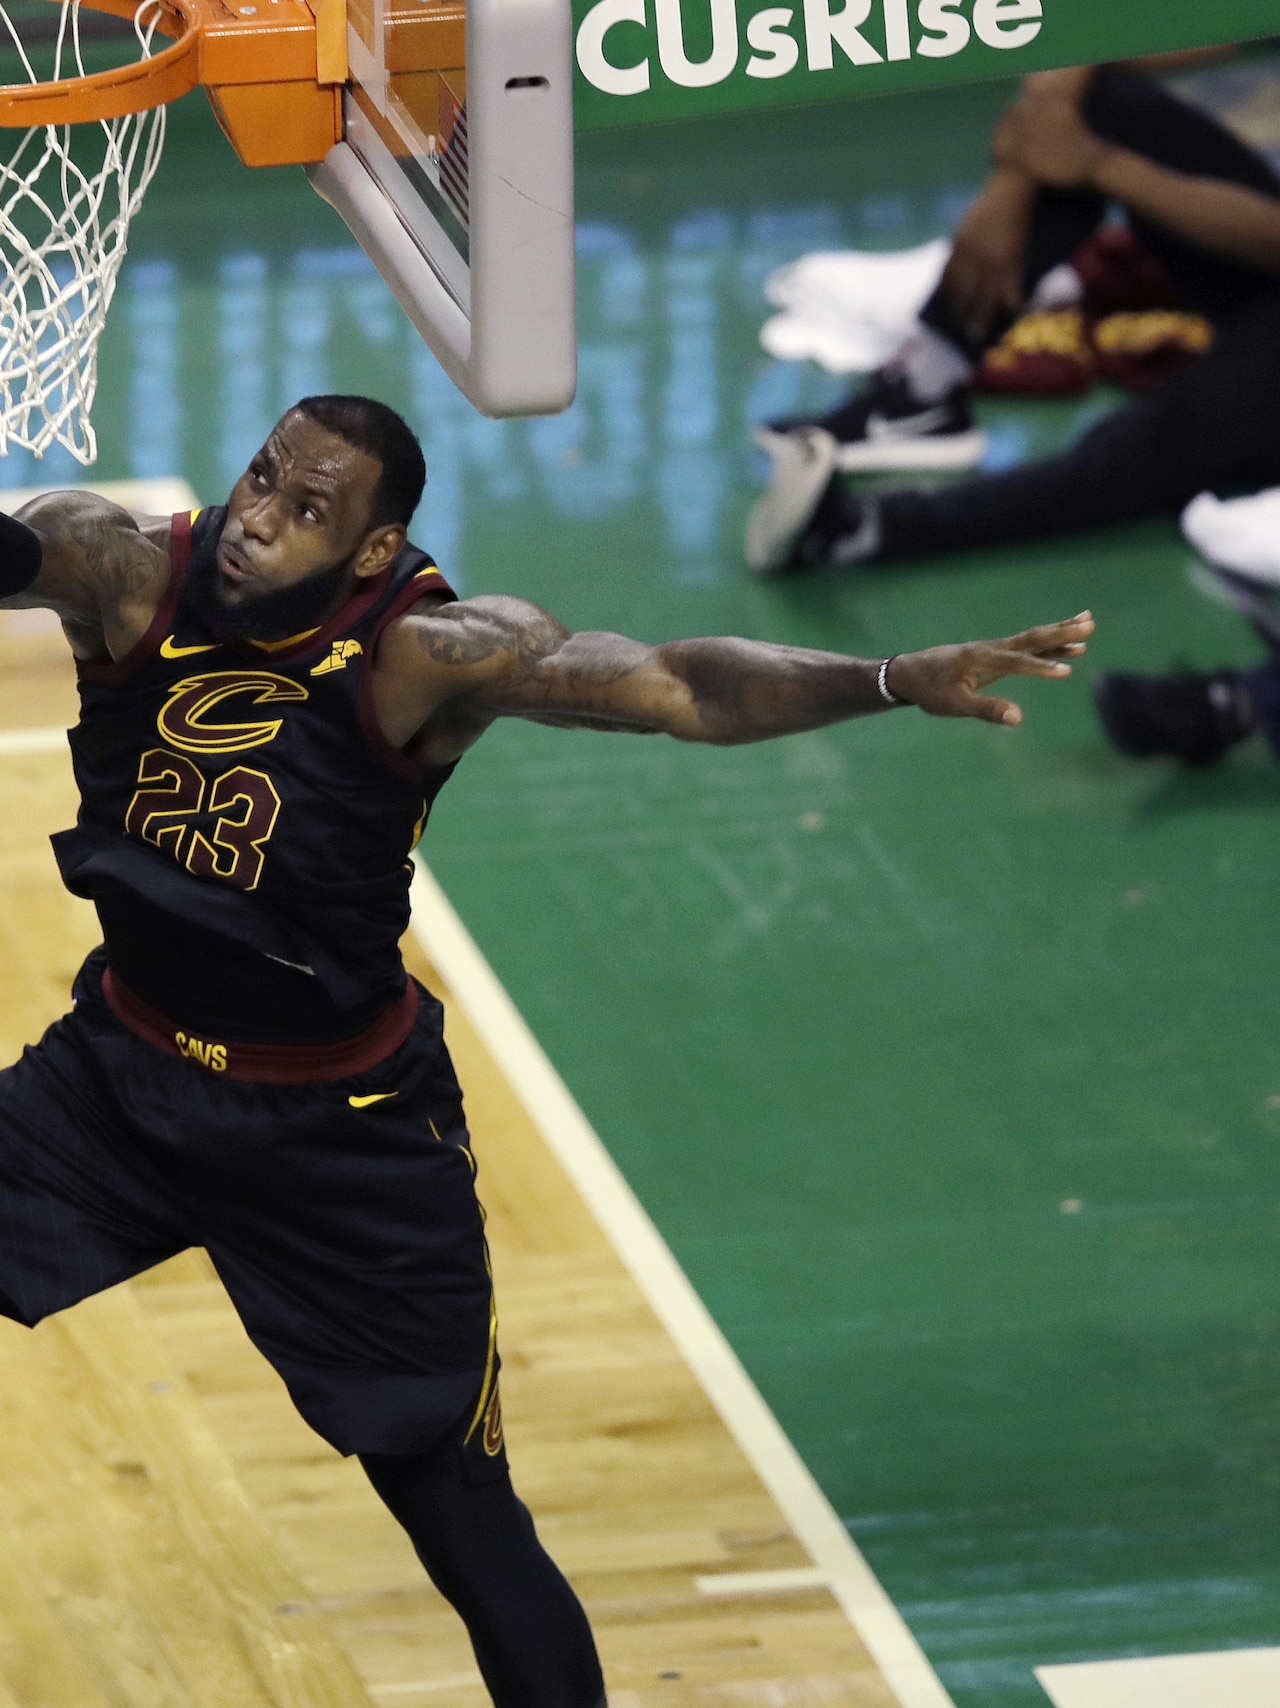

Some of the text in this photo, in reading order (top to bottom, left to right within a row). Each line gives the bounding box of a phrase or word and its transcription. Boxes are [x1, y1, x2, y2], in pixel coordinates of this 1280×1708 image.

[157, 670, 310, 754] C
[125, 748, 282, 892] 23
[175, 1031, 228, 1072] CAVS
